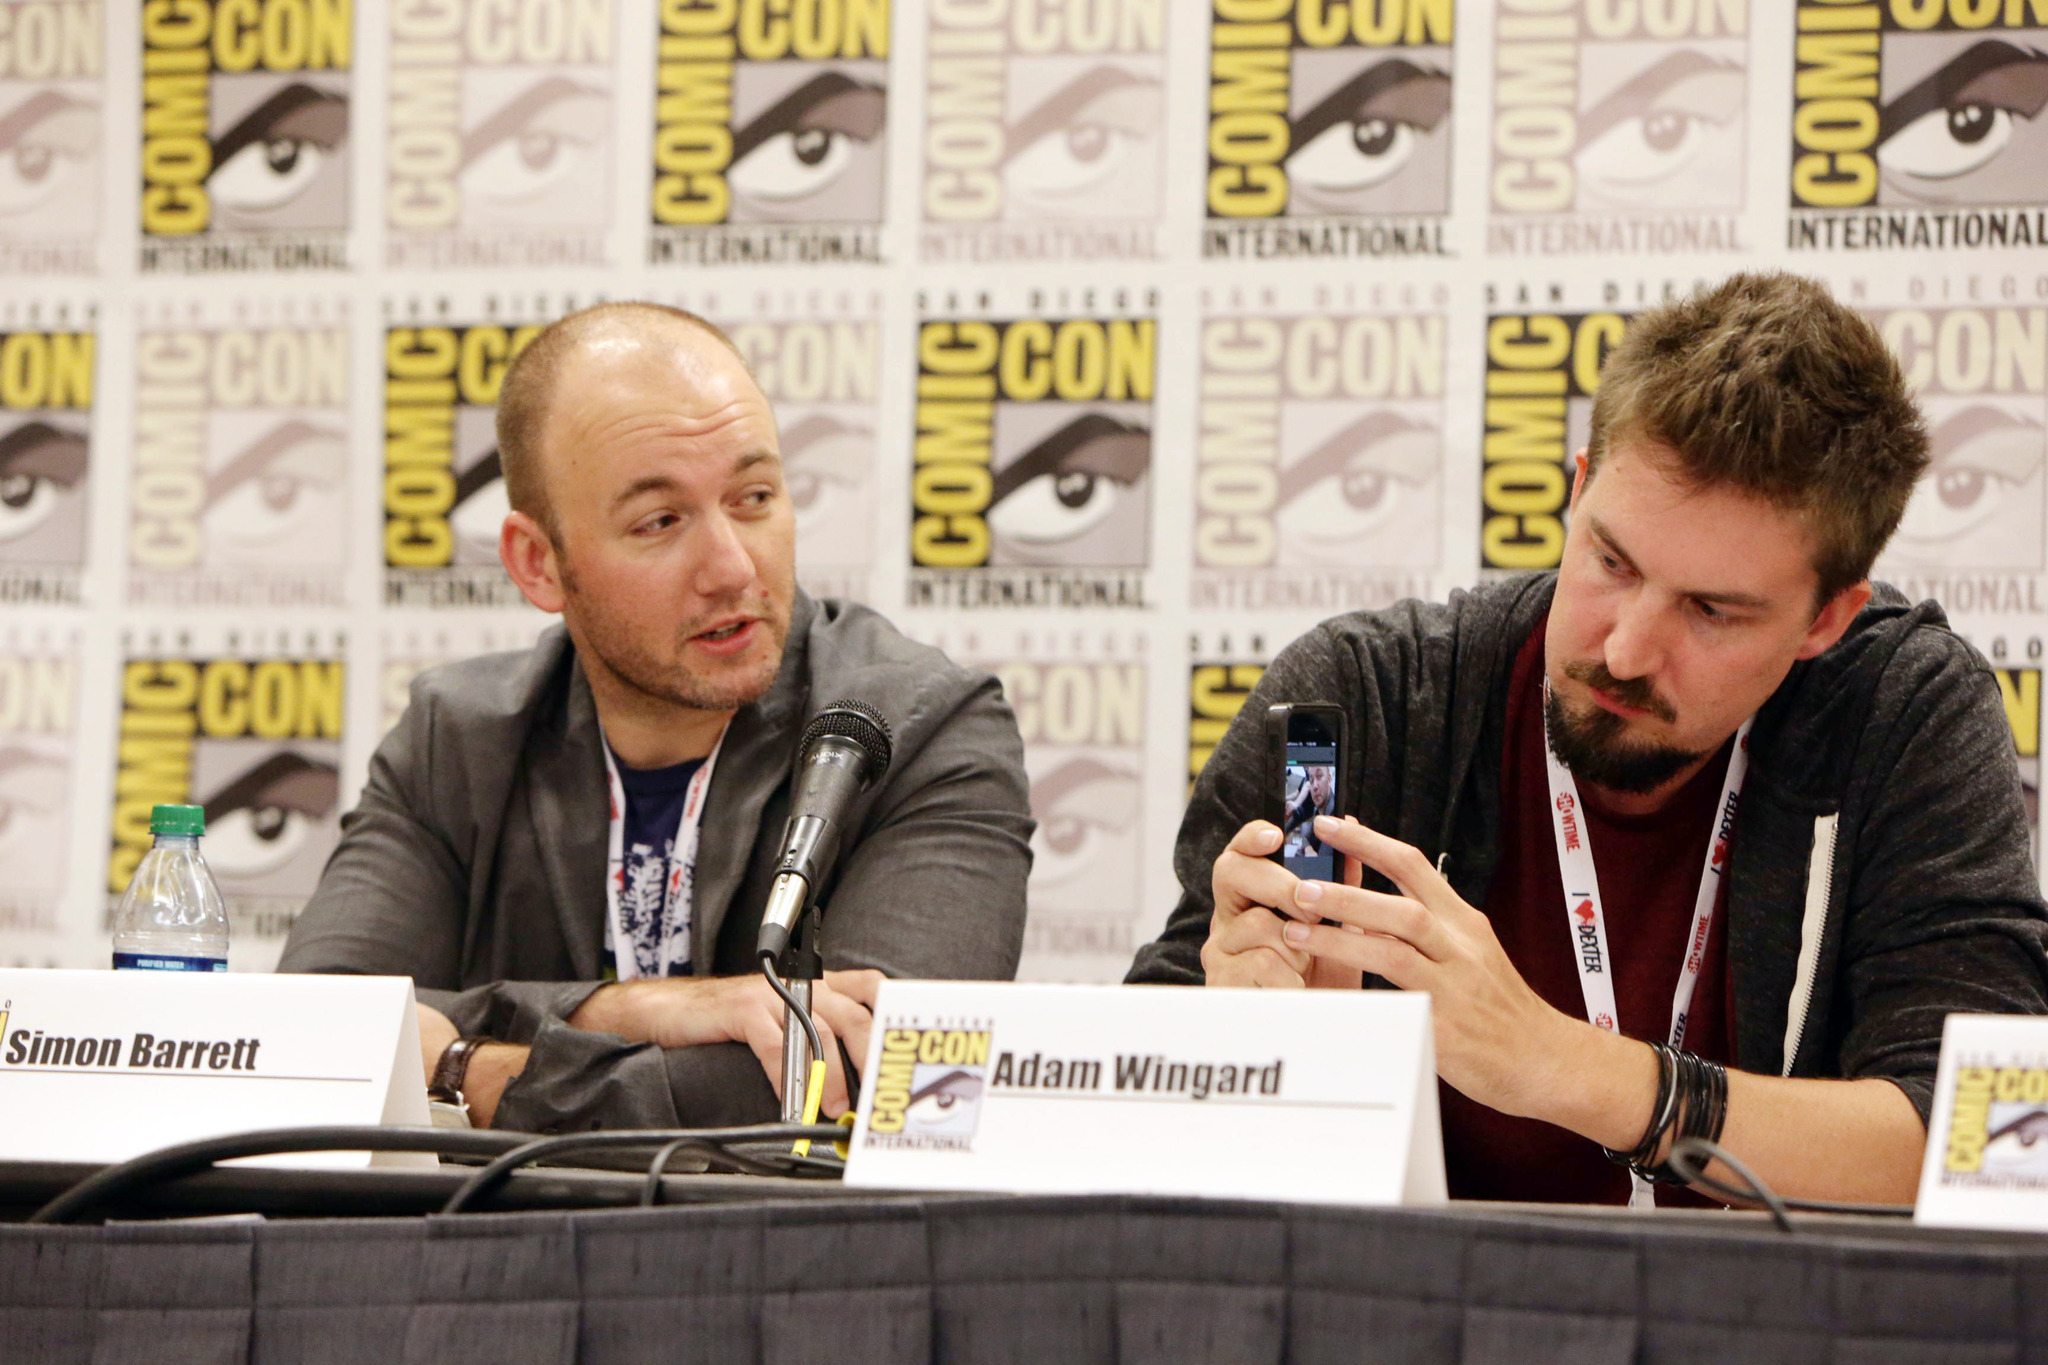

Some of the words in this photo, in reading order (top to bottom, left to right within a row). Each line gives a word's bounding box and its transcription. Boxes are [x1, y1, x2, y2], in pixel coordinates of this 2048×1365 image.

[213, 0, 352, 70] CON
[738, 0, 889, 60] CON
[143, 0, 212, 234] COMIC
[1203, 223, 1456, 258] INTERNATIONAL
[1487, 217, 1744, 254] INTERNATIONAL
[1001, 320, 1157, 401] CON
[1286, 317, 1445, 399] CON
[386, 327, 458, 568] COMIC
[911, 321, 1000, 568] COMIC
[1195, 320, 1284, 567] COMIC
[1484, 315, 1572, 569] COMIC
[201, 661, 343, 739] CON
[1556, 791, 1581, 854] SHOWTIME
[1719, 791, 1740, 841] DEXTER
[1577, 924, 1603, 974] DEXTER
[1687, 914, 1710, 975] SHOWTIME
[5, 1029, 123, 1068] Simon
[127, 1032, 261, 1071] Barrett
[868, 1028, 921, 1133] COMIC
[918, 1029, 992, 1066] CON
[991, 1051, 1101, 1090] Adam
[1113, 1055, 1284, 1101] Wingard
